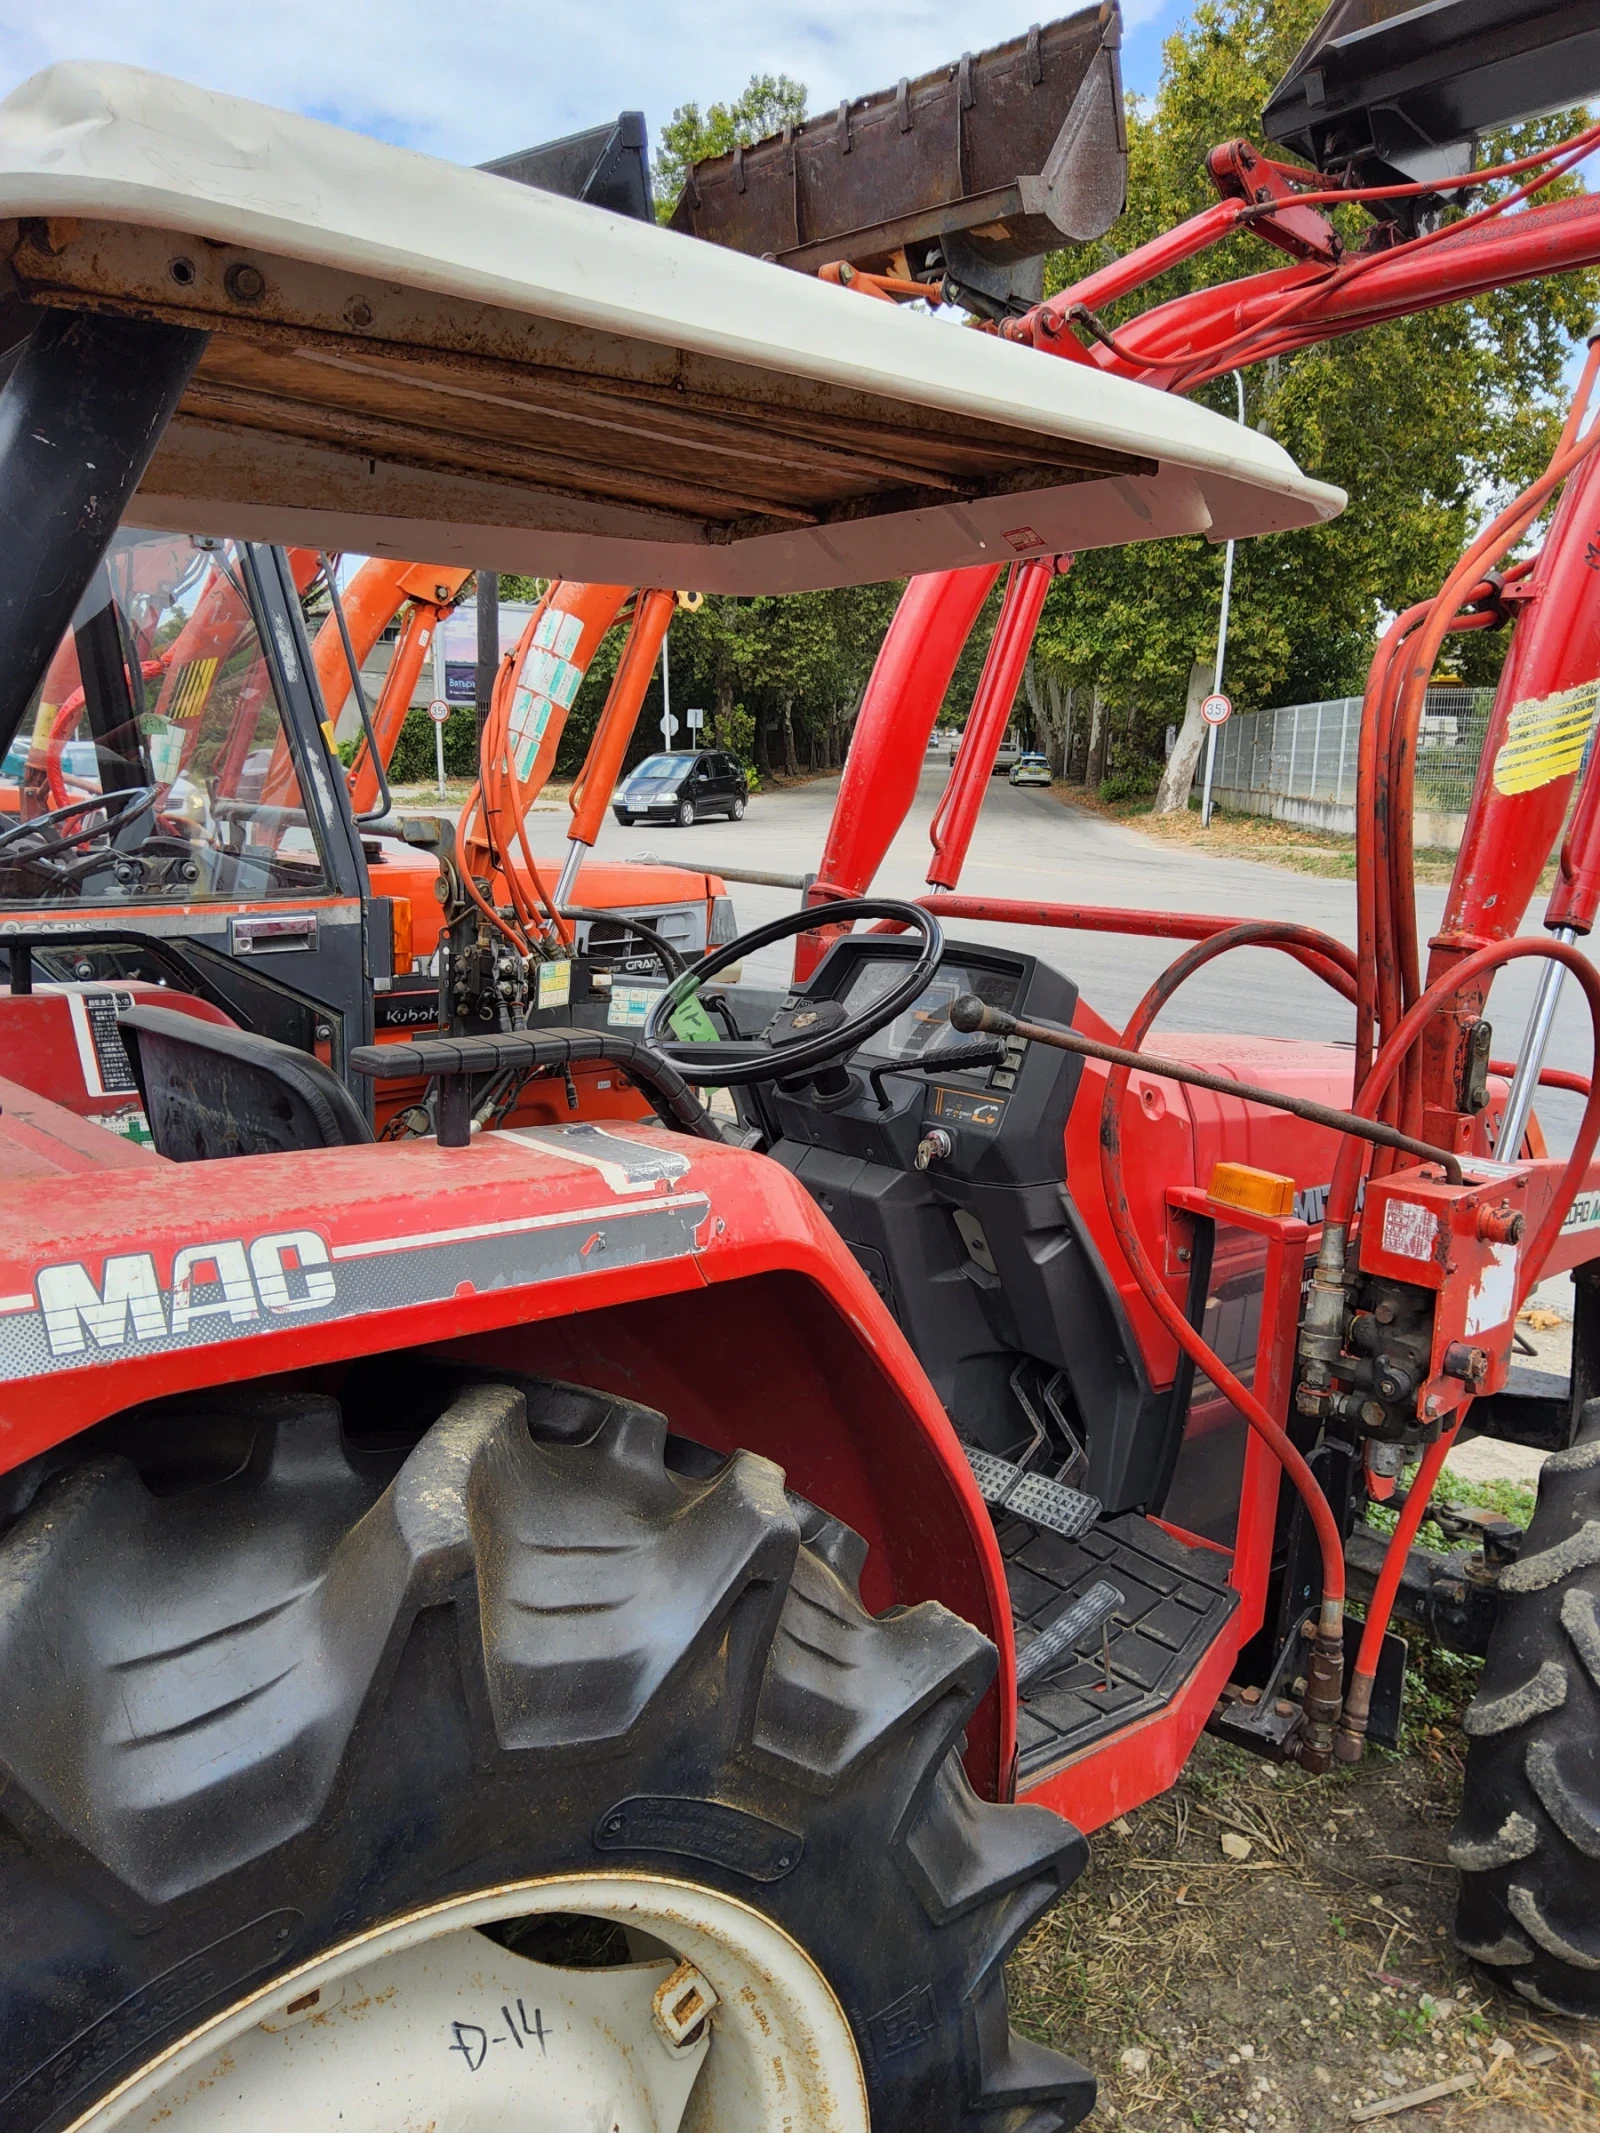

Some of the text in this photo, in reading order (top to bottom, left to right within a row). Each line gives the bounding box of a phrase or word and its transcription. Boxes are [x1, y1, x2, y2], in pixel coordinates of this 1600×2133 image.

[35, 1230, 337, 1357] MAC
[448, 1998, 554, 2073] D-14
[750, 2003, 773, 2038] JAPAN
